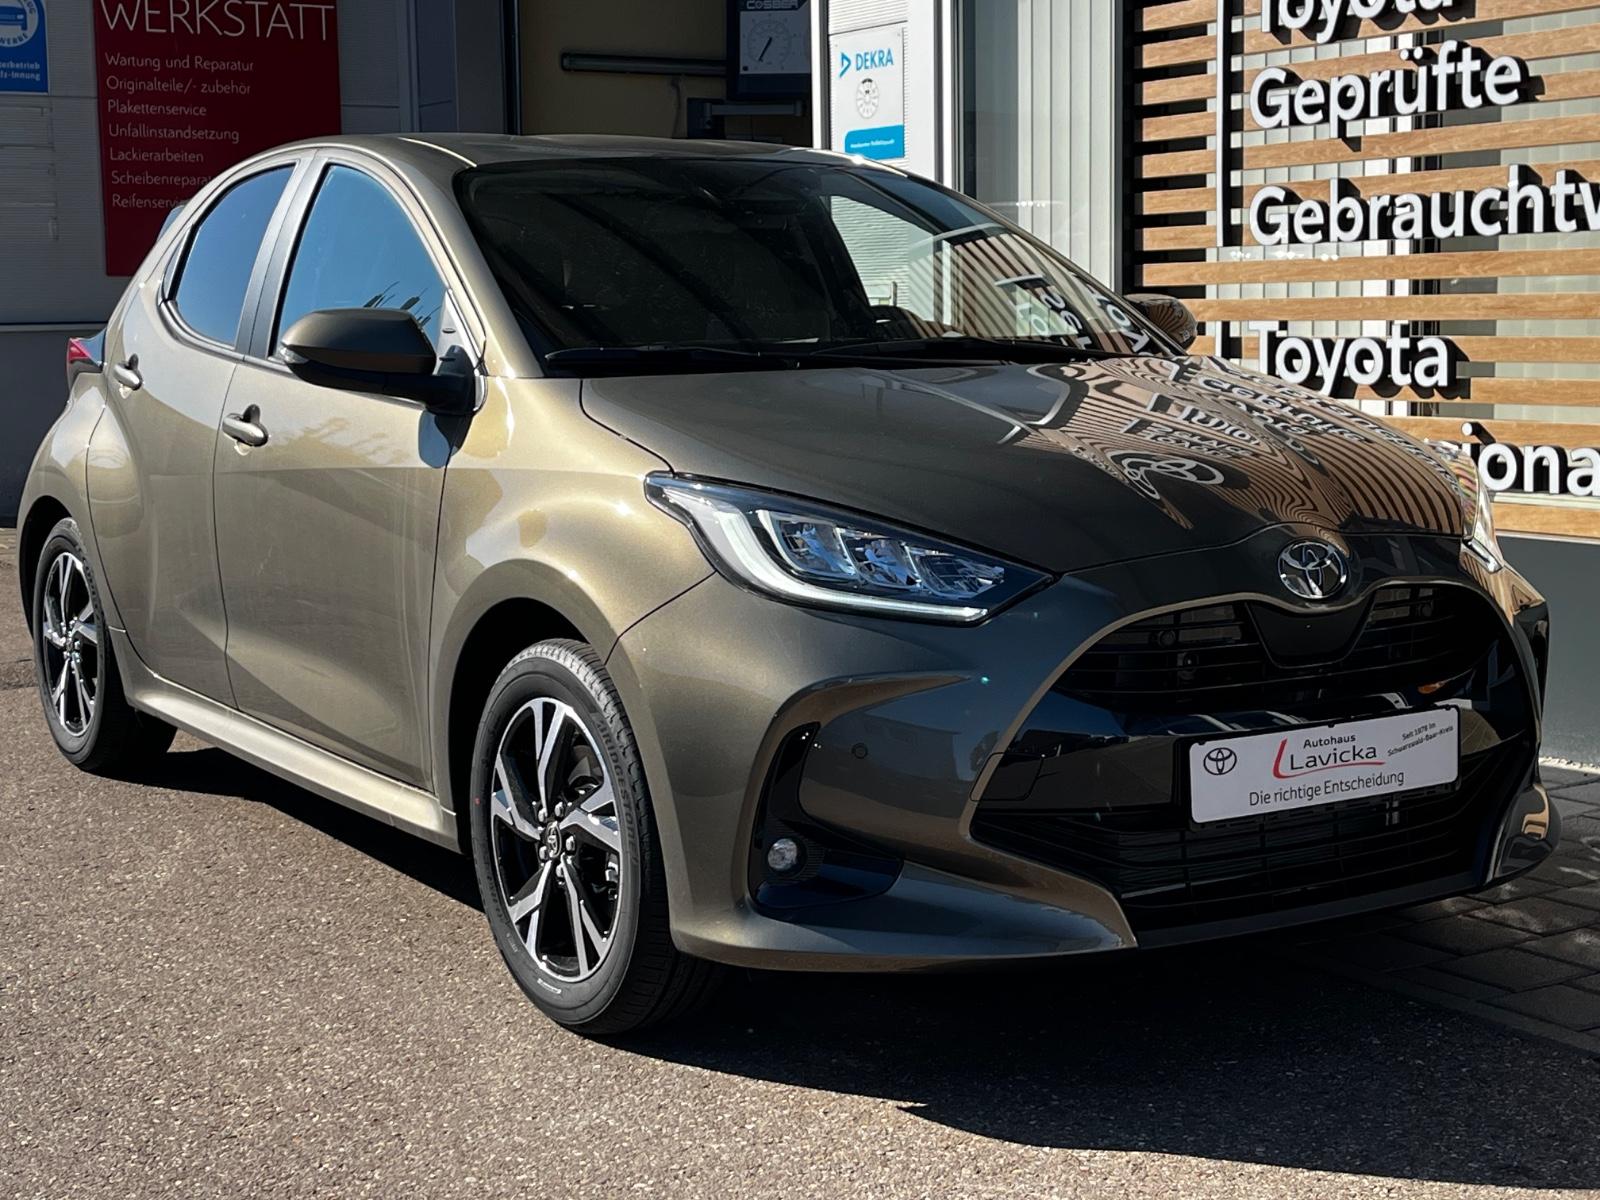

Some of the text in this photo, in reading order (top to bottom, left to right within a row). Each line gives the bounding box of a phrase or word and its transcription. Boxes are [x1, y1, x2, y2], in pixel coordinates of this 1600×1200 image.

[101, 0, 335, 41] WERKSTATT
[1260, 0, 1455, 44] Toy
[105, 52, 254, 73] Wartung und Reparatur
[856, 48, 894, 71] DEKRA
[1250, 40, 1522, 138] Geprüfte
[108, 99, 207, 117] Plakettenservice
[108, 124, 240, 143] Unfallinstandsetzung
[109, 147, 204, 163] Lackierarbeiten
[1248, 320, 1451, 396] Toyota
[1303, 733, 1356, 750] Autohaus
[1289, 744, 1377, 771] Lavicka
[1249, 771, 1405, 806] Die richtige Entscheidung
